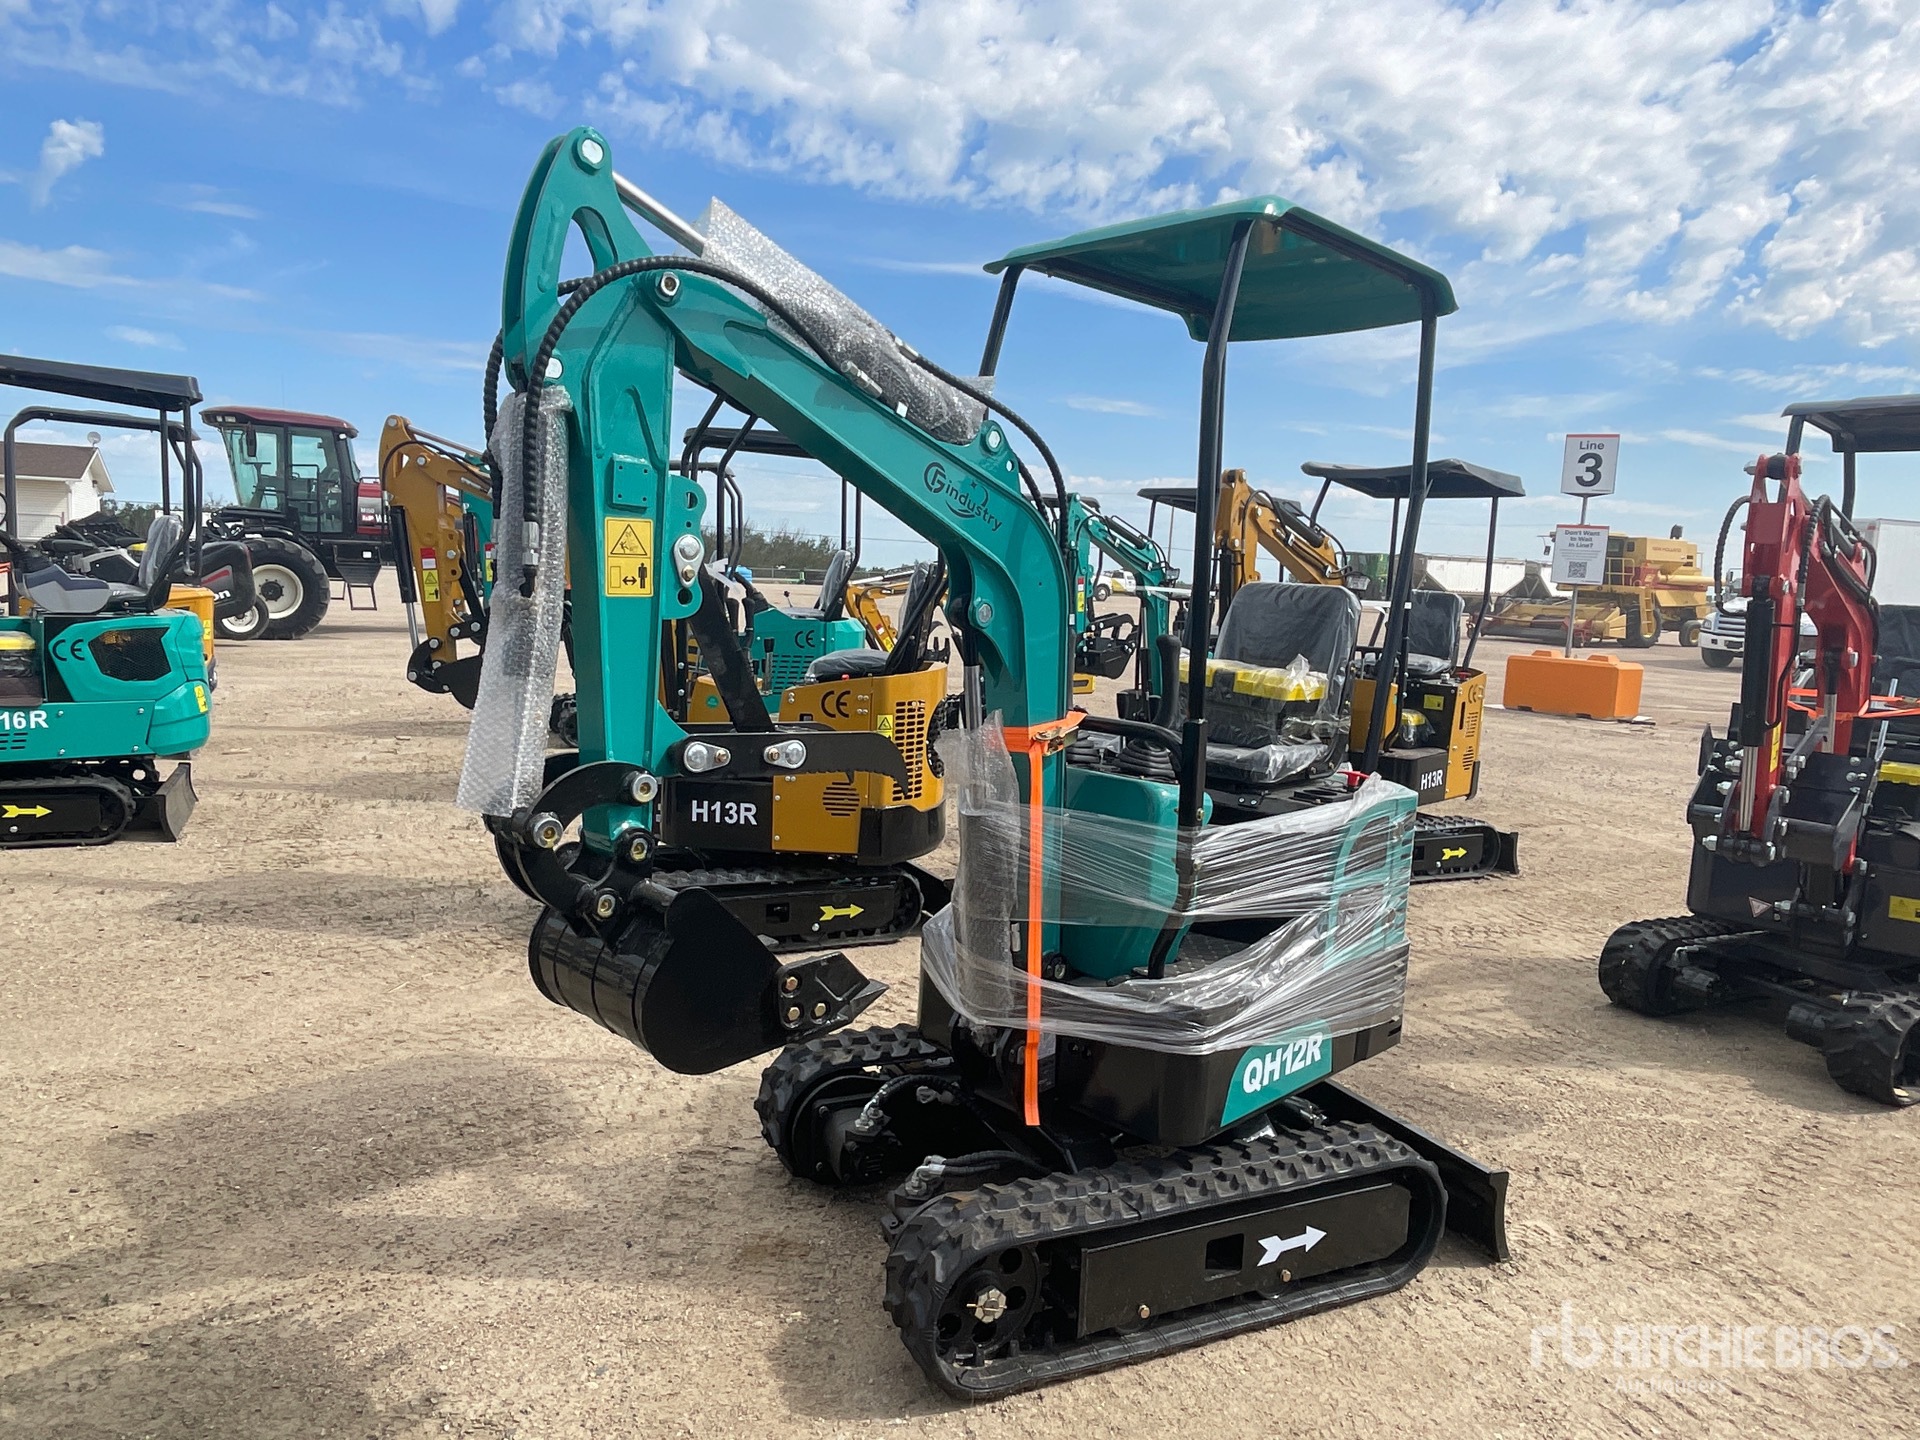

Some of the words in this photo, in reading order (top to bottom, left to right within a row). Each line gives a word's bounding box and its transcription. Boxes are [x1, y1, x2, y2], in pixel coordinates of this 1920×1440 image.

[1579, 440, 1605, 450] Line
[1575, 452, 1603, 487] 3
[1420, 768, 1444, 791] H13R
[691, 799, 758, 826] H13R
[1242, 1031, 1324, 1094] QH12R
